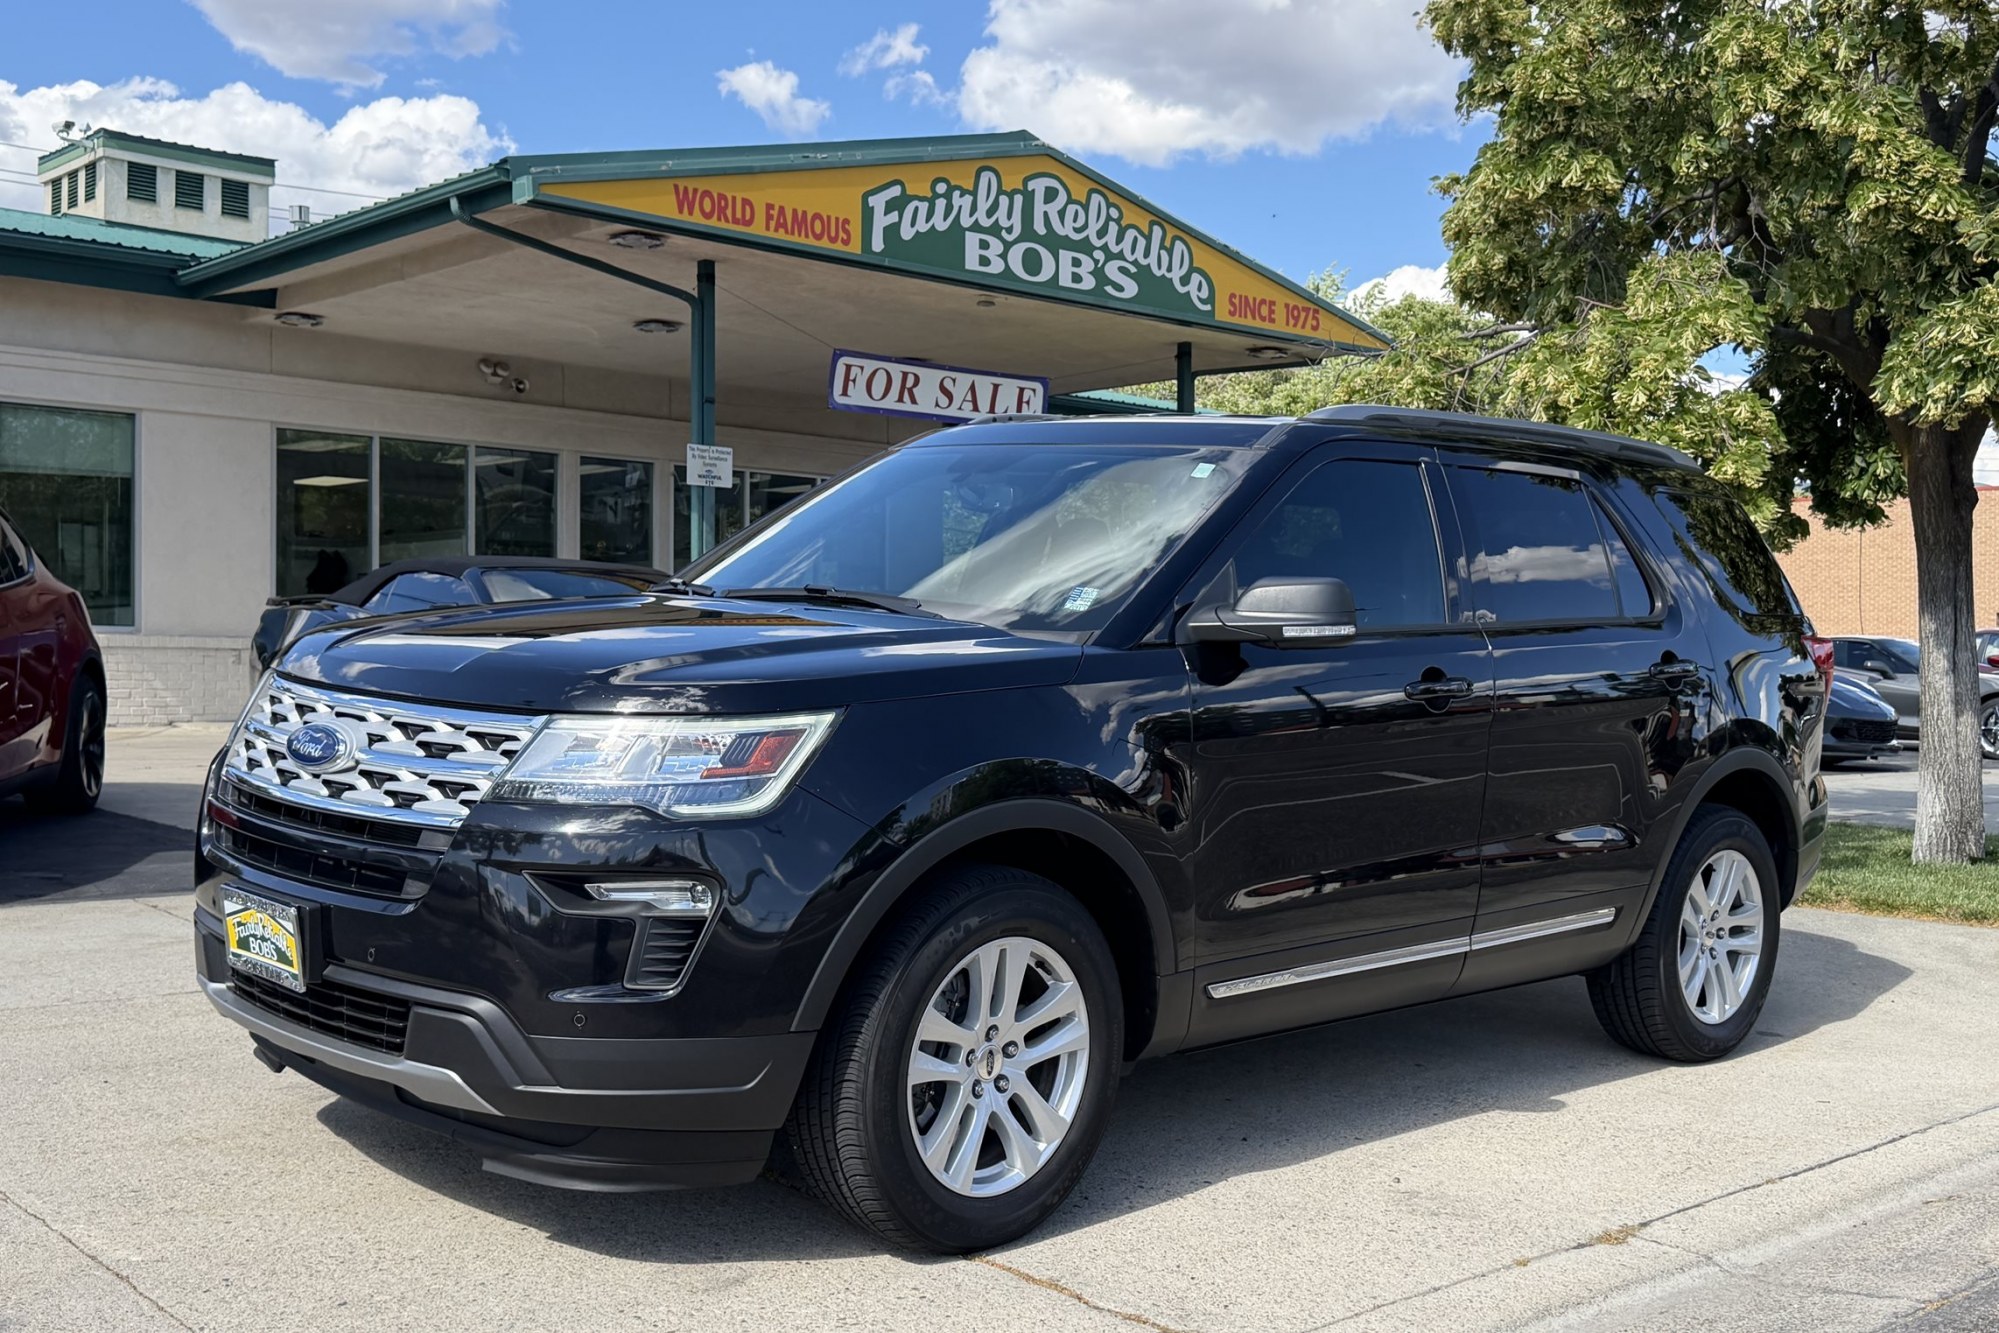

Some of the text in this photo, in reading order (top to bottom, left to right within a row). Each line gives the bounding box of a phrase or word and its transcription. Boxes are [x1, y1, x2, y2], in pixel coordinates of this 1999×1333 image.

[673, 183, 852, 247] WORLD FAMOUS
[868, 170, 1212, 311] Fairly Reliable
[965, 230, 1139, 299] BOB'S
[1228, 292, 1320, 332] SINCE 1975
[838, 362, 1037, 415] FOR SALE
[292, 729, 328, 758] Ford
[232, 914, 262, 940] Fairly
